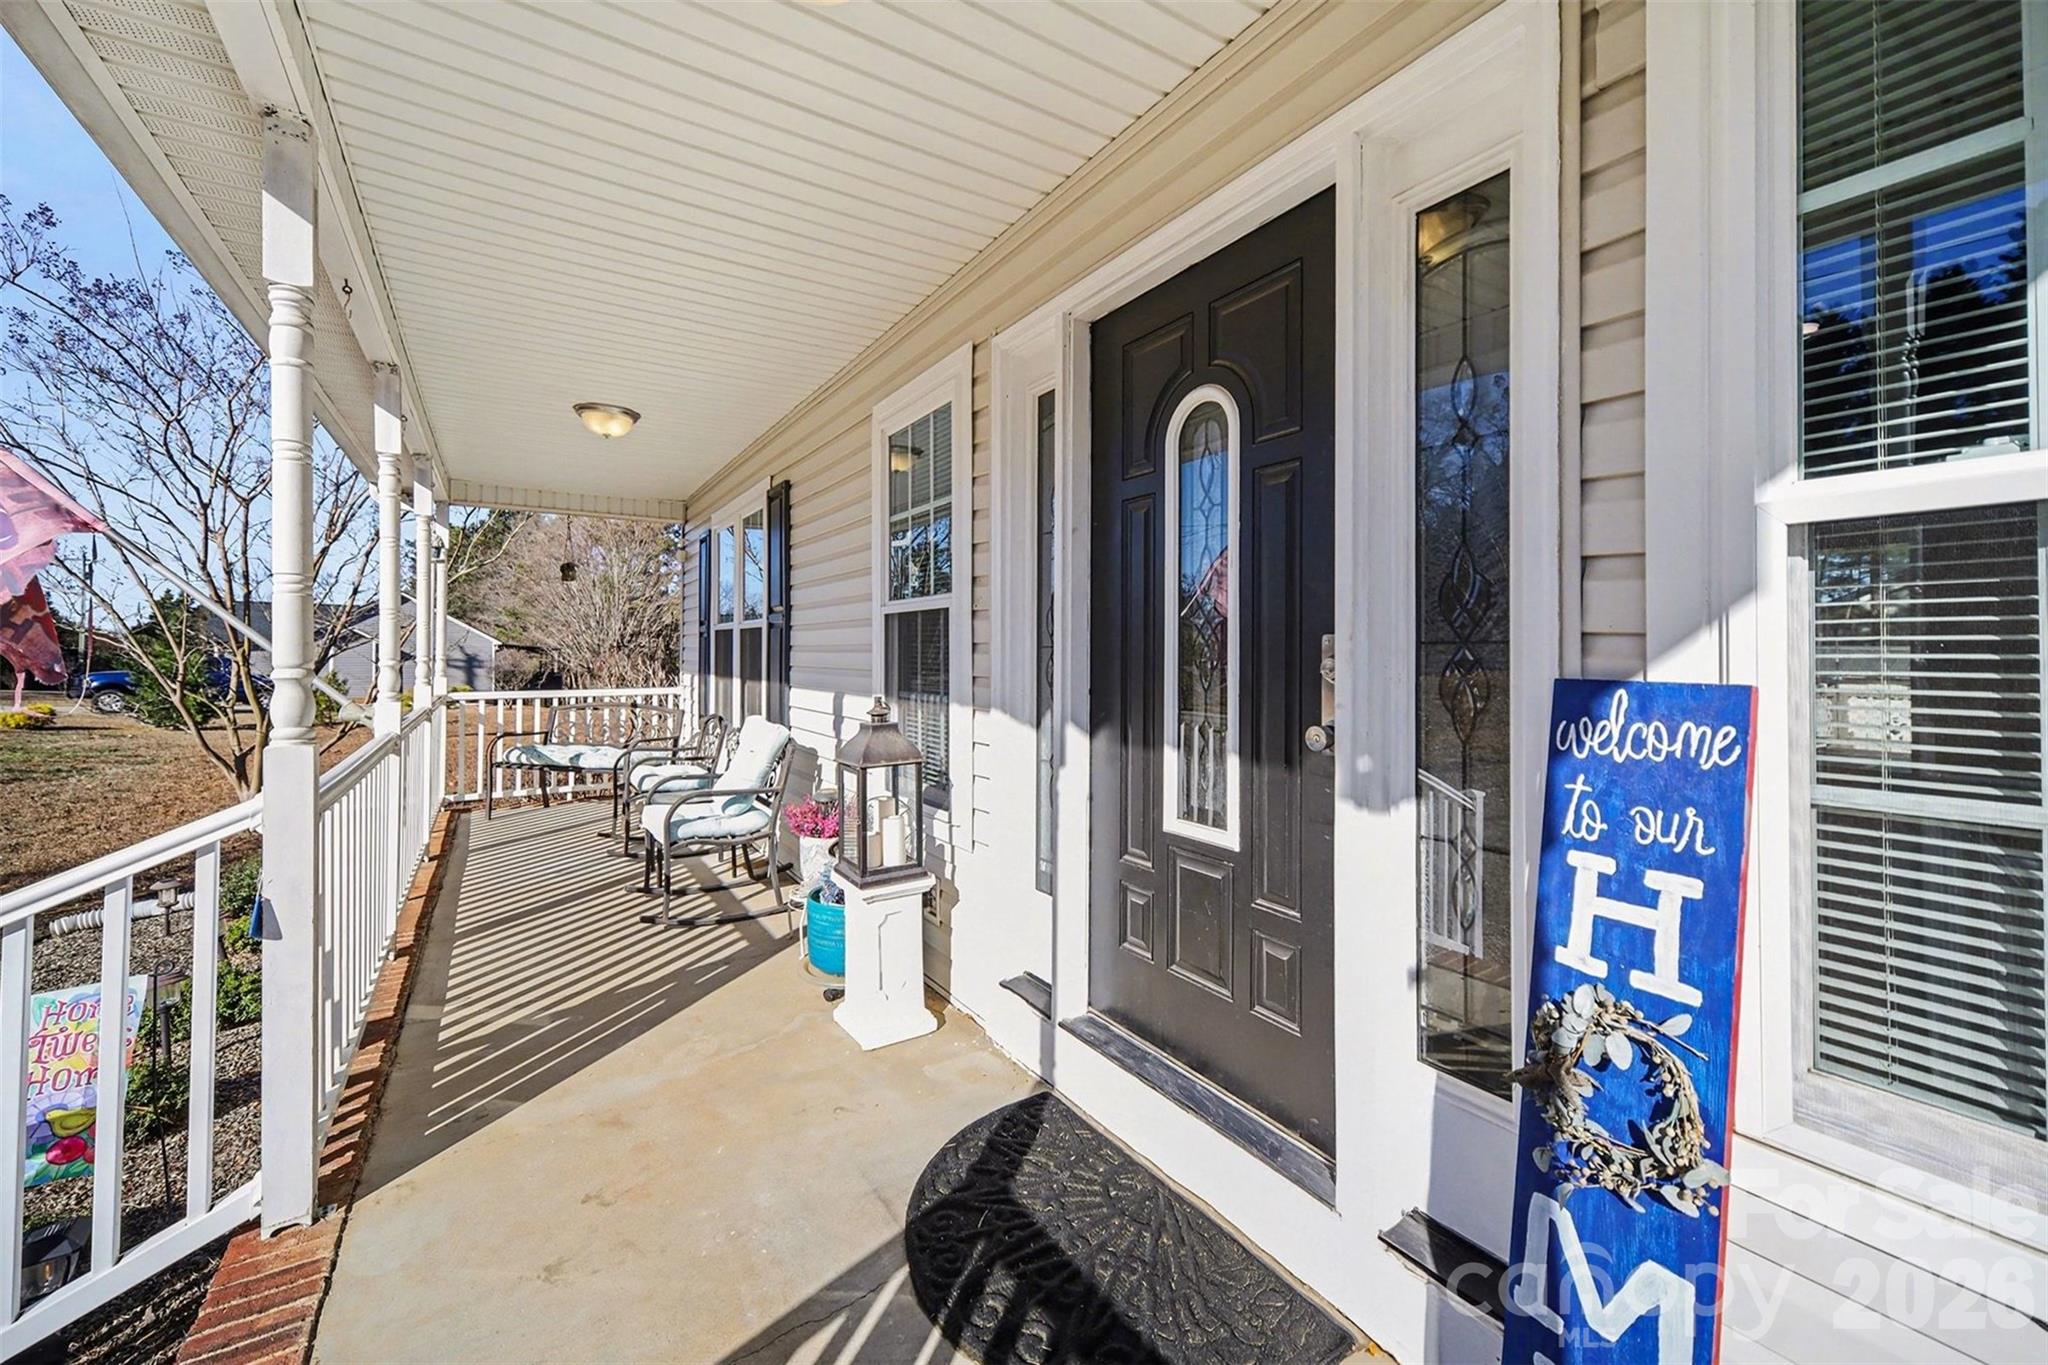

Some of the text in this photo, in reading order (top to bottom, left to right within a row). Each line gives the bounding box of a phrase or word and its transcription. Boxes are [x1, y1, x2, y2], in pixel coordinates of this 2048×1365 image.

[1556, 688, 1742, 770] welcome
[1561, 773, 1716, 856] to our
[26, 1065, 99, 1100] Hom
